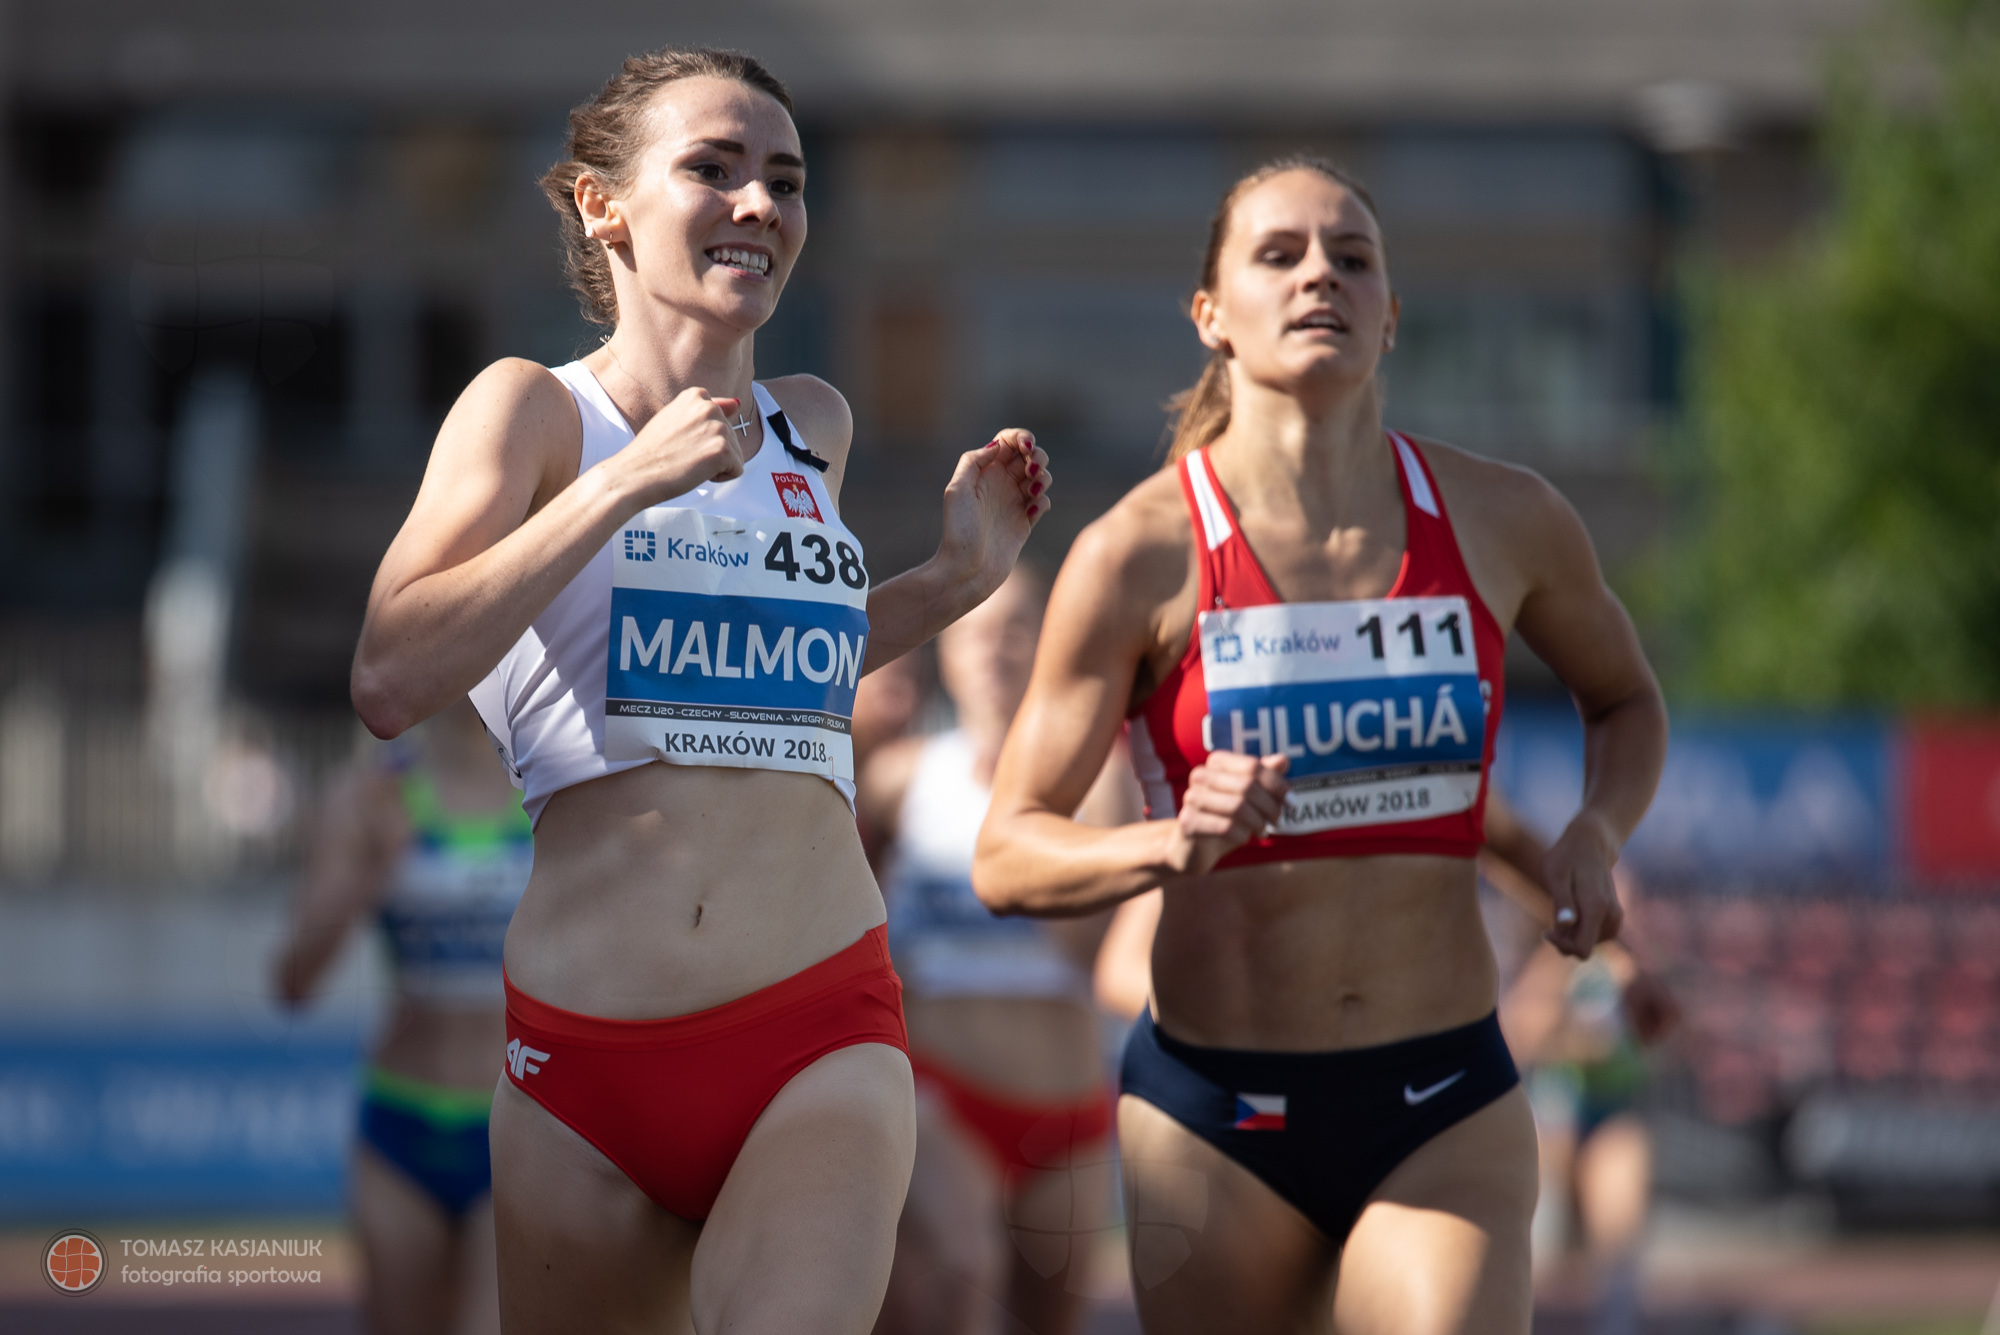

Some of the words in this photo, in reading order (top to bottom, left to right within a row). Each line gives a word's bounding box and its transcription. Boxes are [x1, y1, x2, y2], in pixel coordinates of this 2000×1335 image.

[774, 475, 806, 485] POLSKA
[666, 536, 749, 568] Kraków
[763, 531, 867, 590] 438
[618, 615, 865, 690] MALMON
[1252, 628, 1341, 657] Kraków
[1355, 611, 1465, 660] 111
[619, 704, 652, 714] MECZ
[653, 706, 674, 716] U20
[1230, 684, 1468, 758] HLUCHÁ
[664, 730, 776, 758] KRAKÓW
[783, 738, 827, 763] 2018
[1283, 792, 1370, 825] RAKÓW
[1376, 787, 1431, 814] 2018
